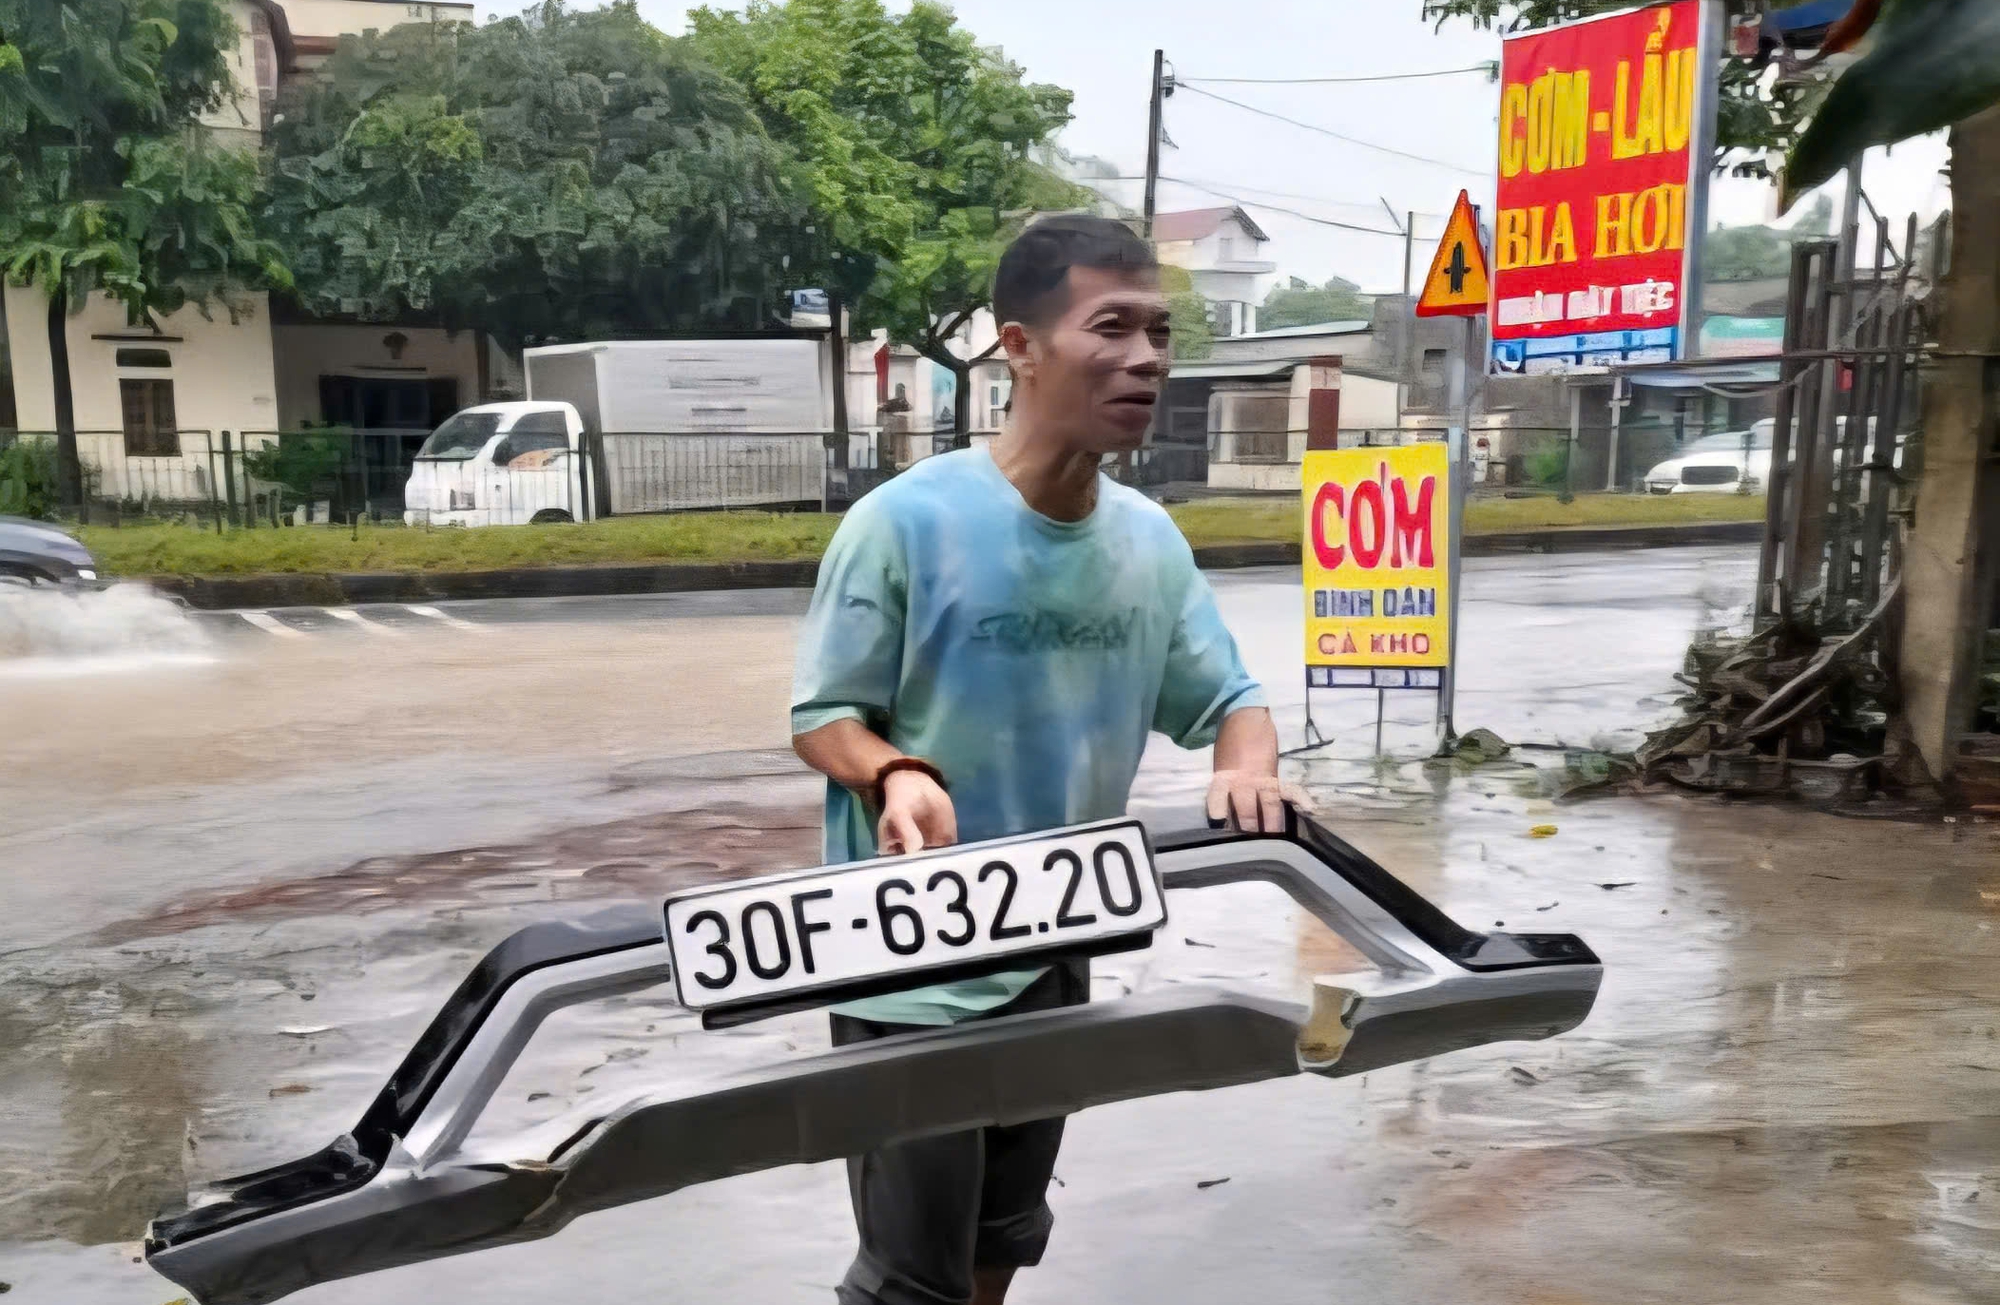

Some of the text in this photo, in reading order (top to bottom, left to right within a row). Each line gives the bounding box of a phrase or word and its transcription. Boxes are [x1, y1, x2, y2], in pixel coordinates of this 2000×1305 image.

[1497, 201, 1577, 270] BIA
[1311, 461, 1436, 570] CƠM
[1370, 632, 1431, 655] KHO
